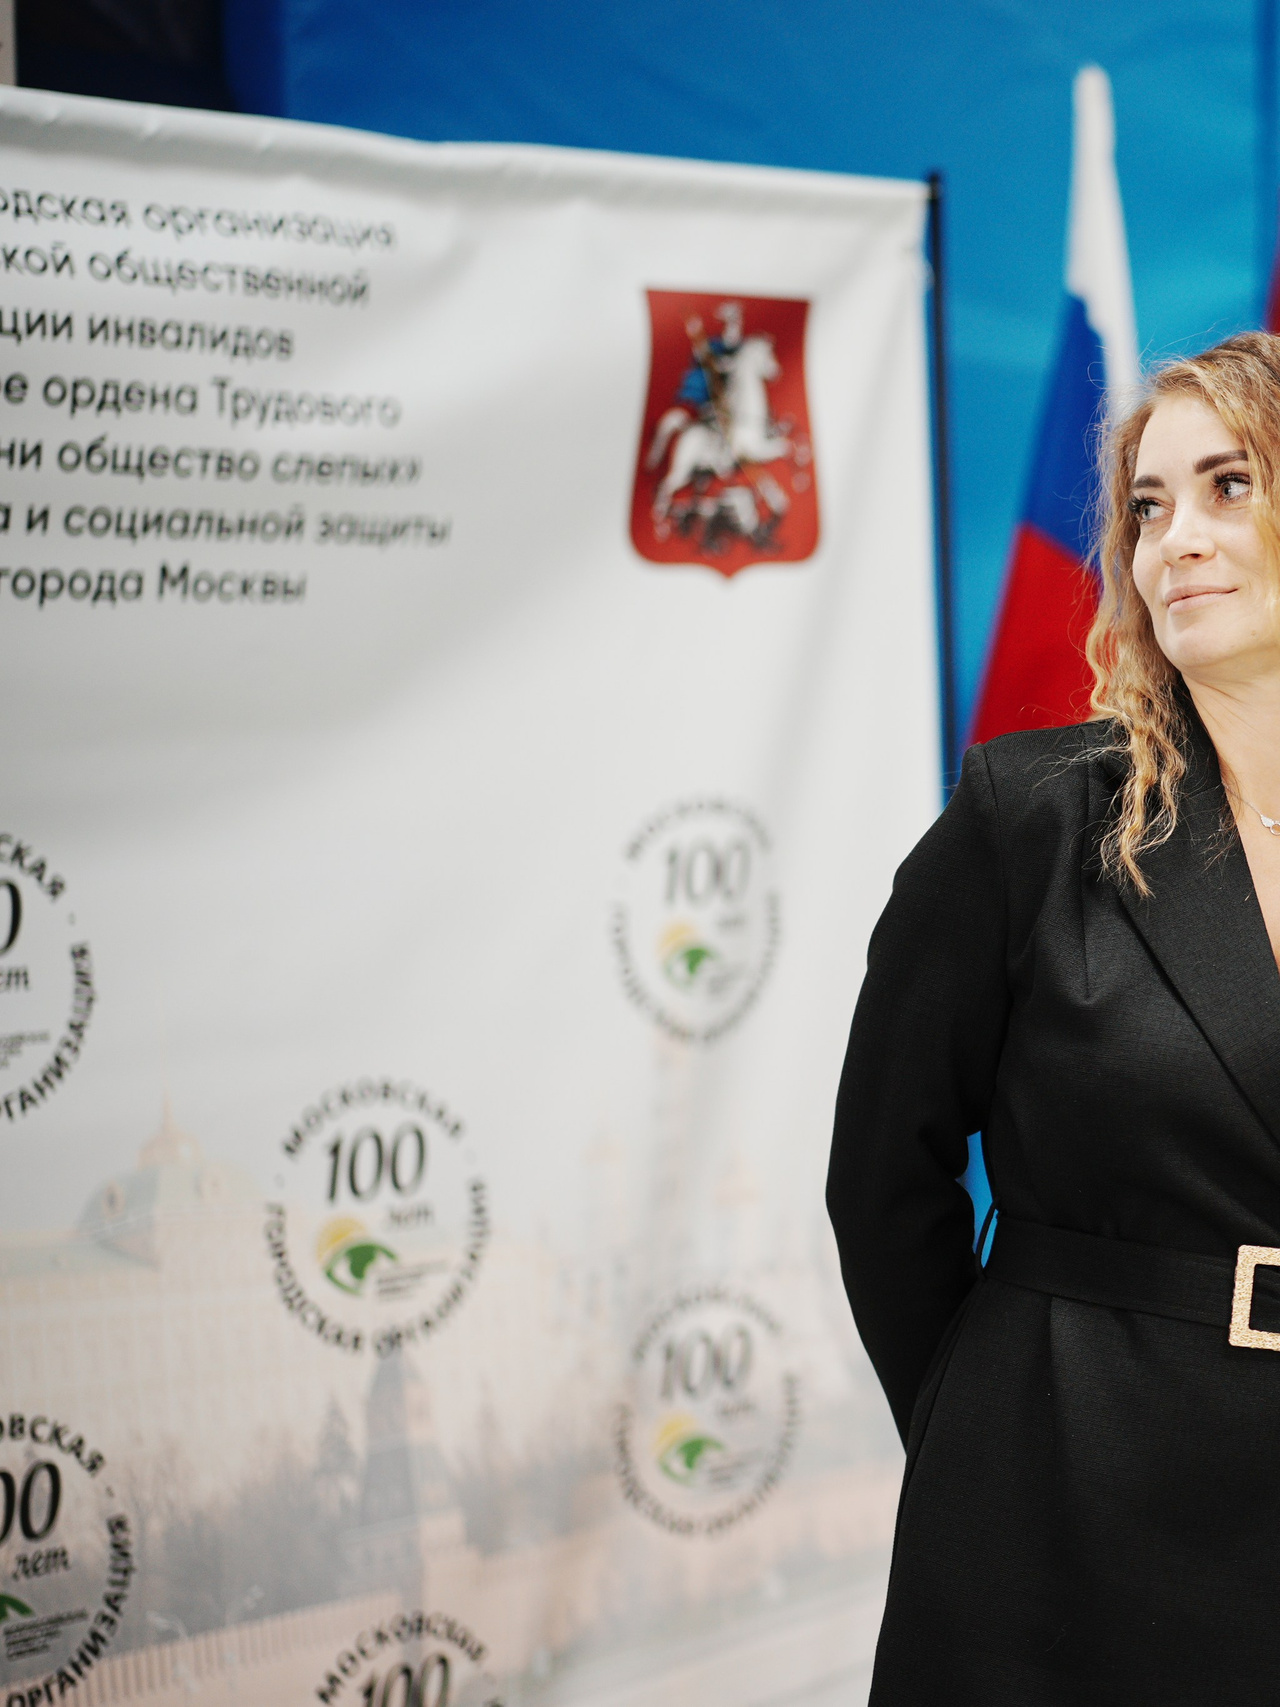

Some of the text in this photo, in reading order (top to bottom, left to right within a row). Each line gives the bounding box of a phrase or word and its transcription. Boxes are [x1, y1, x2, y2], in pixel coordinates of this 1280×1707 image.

[143, 205, 394, 251] организация
[89, 248, 369, 305] общественной
[87, 315, 294, 363] инвалидов
[42, 374, 198, 419] ордена
[211, 377, 401, 428] Трудового
[57, 434, 260, 482] общество
[25, 503, 50, 536] и
[62, 502, 304, 543] социальной
[315, 515, 448, 551] защиты
[156, 561, 306, 604] Москвы
[661, 839, 752, 906] 100
[326, 1122, 426, 1206] 100
[660, 1324, 754, 1402] 100
[0, 1412, 105, 1477] ВСКАЯ
[12, 1546, 70, 1581] лет
